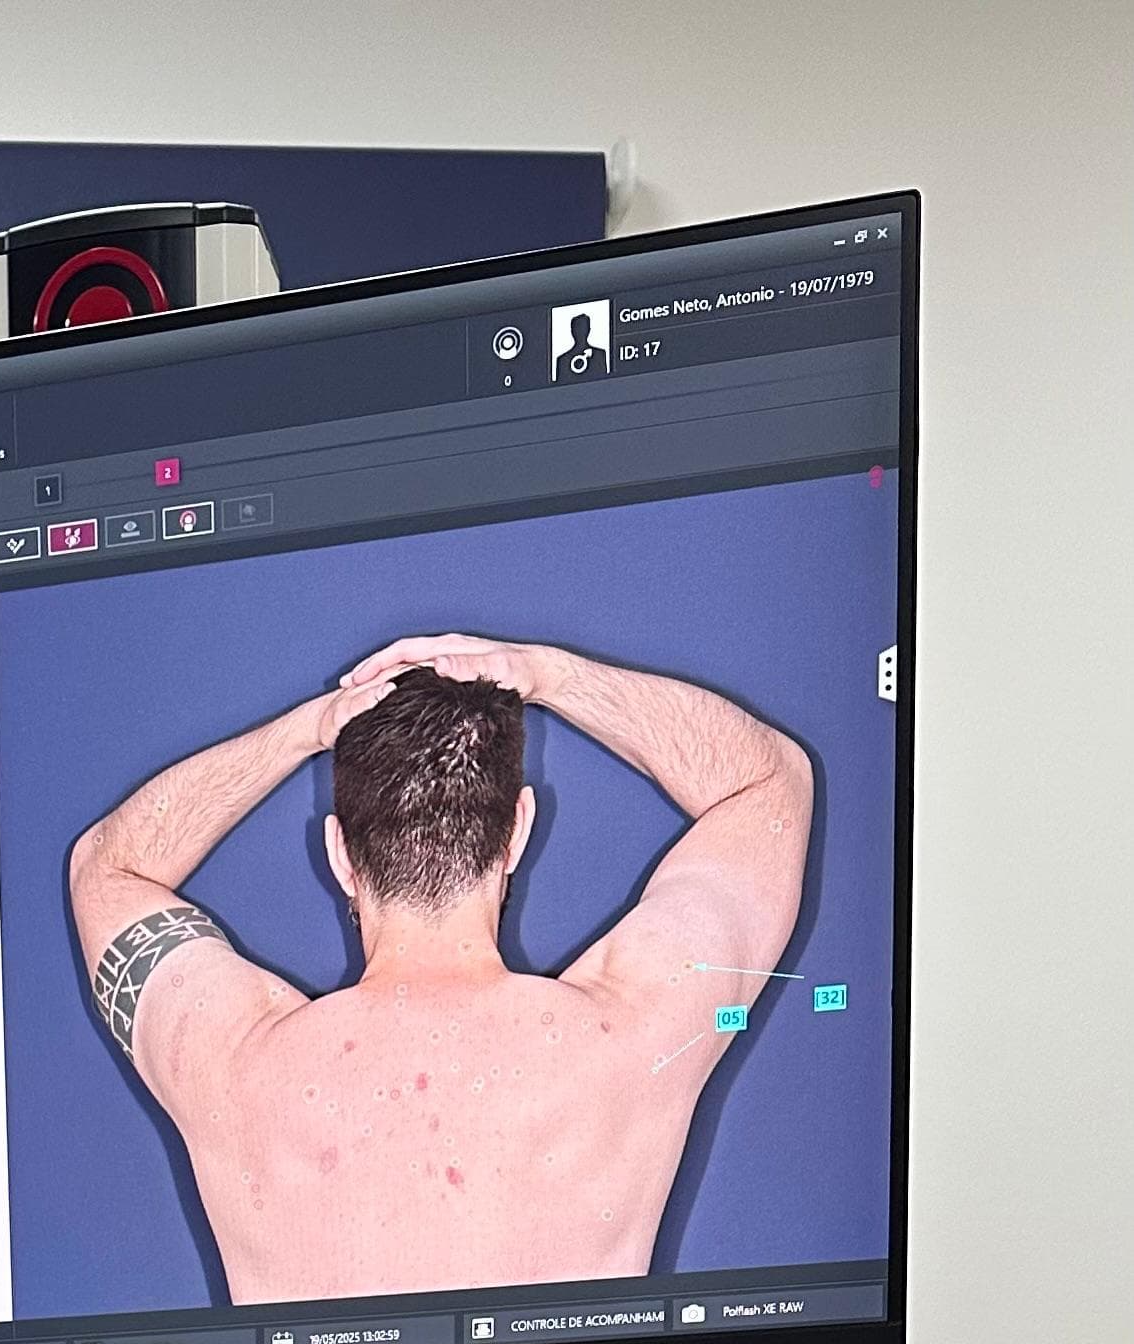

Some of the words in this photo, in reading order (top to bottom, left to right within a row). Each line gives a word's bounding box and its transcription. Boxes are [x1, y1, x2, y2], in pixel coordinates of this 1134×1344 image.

[619, 305, 670, 323] Gomes
[673, 297, 713, 315] Neto,
[716, 286, 775, 308] Antonio
[790, 270, 874, 297] 19/07/1979
[619, 345, 639, 361] ID:
[643, 341, 661, 357] 17
[504, 375, 512, 387] 0
[164, 467, 172, 479] 2
[816, 989, 845, 1008] [32]
[717, 1010, 745, 1028] [05]
[762, 1303, 777, 1315] XE
[779, 1301, 804, 1314] RAW
[510, 1317, 566, 1332] CONTROLE
[568, 1315, 583, 1328] DE
